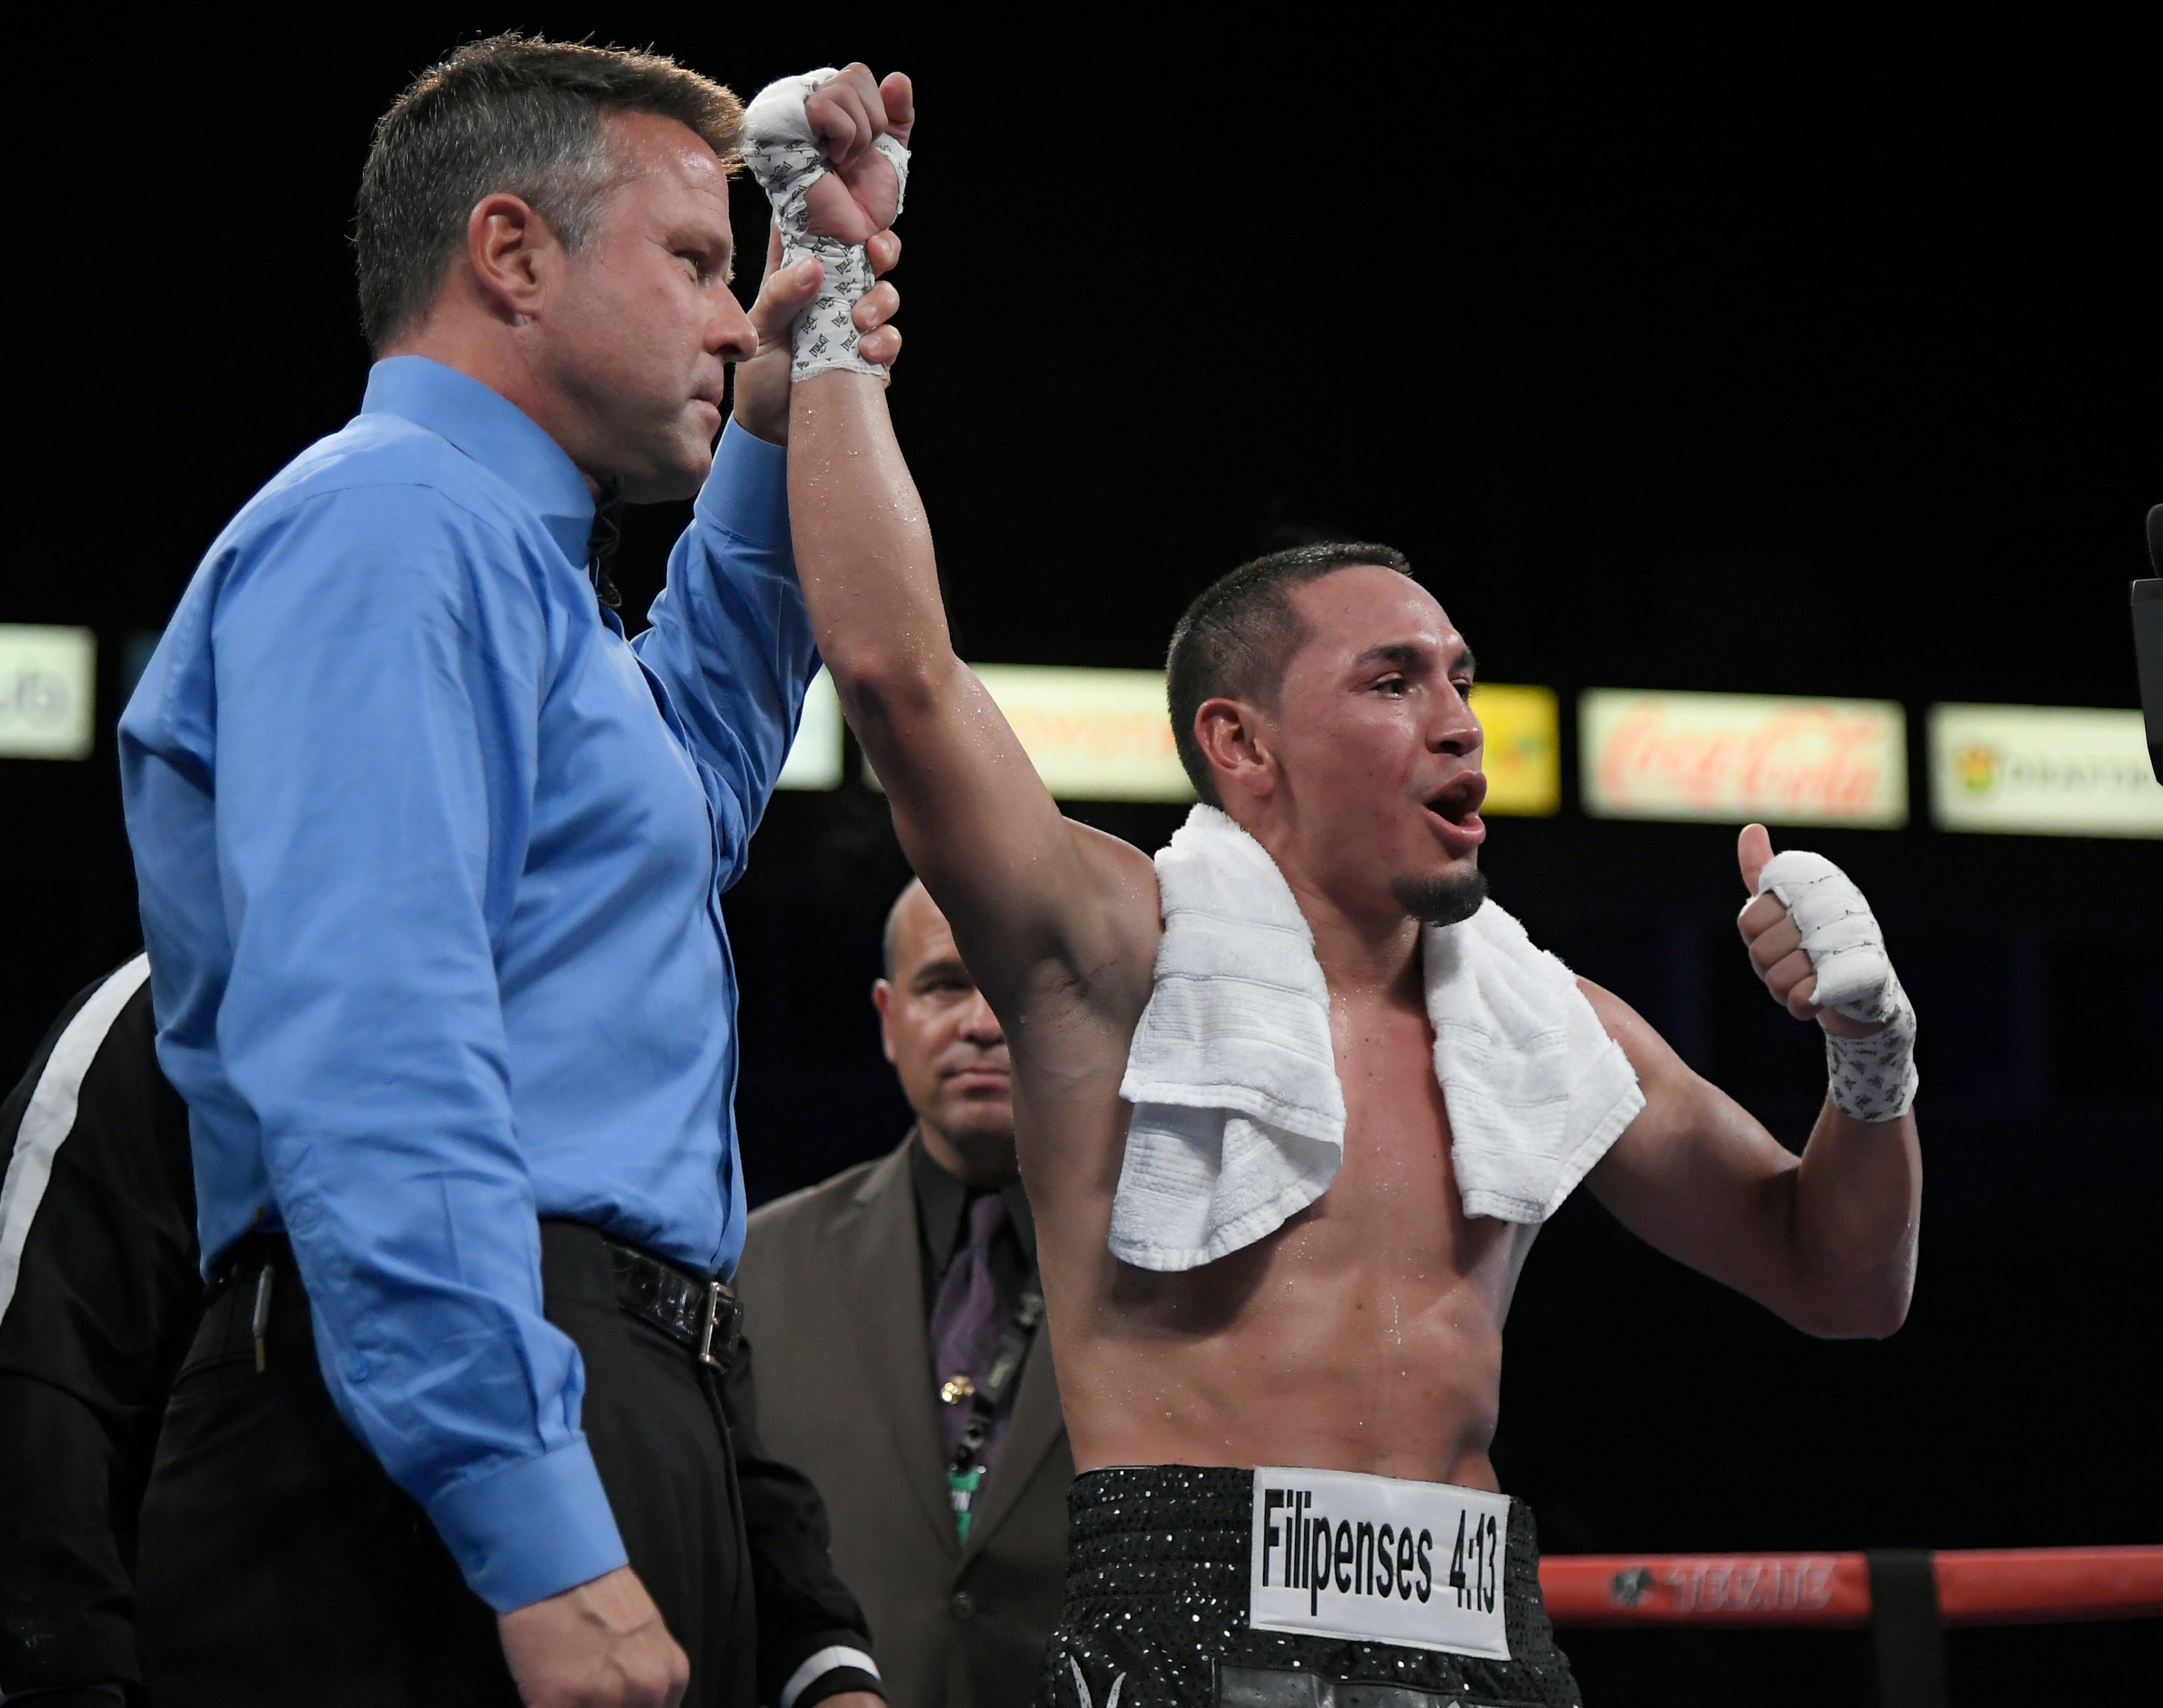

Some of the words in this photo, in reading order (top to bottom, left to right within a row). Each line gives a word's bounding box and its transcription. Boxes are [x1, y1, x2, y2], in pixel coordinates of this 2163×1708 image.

[809, 333, 830, 358] EVERLAST
[1262, 1488, 1433, 1616] Filipenses
[1449, 1509, 1497, 1615] 4:13
